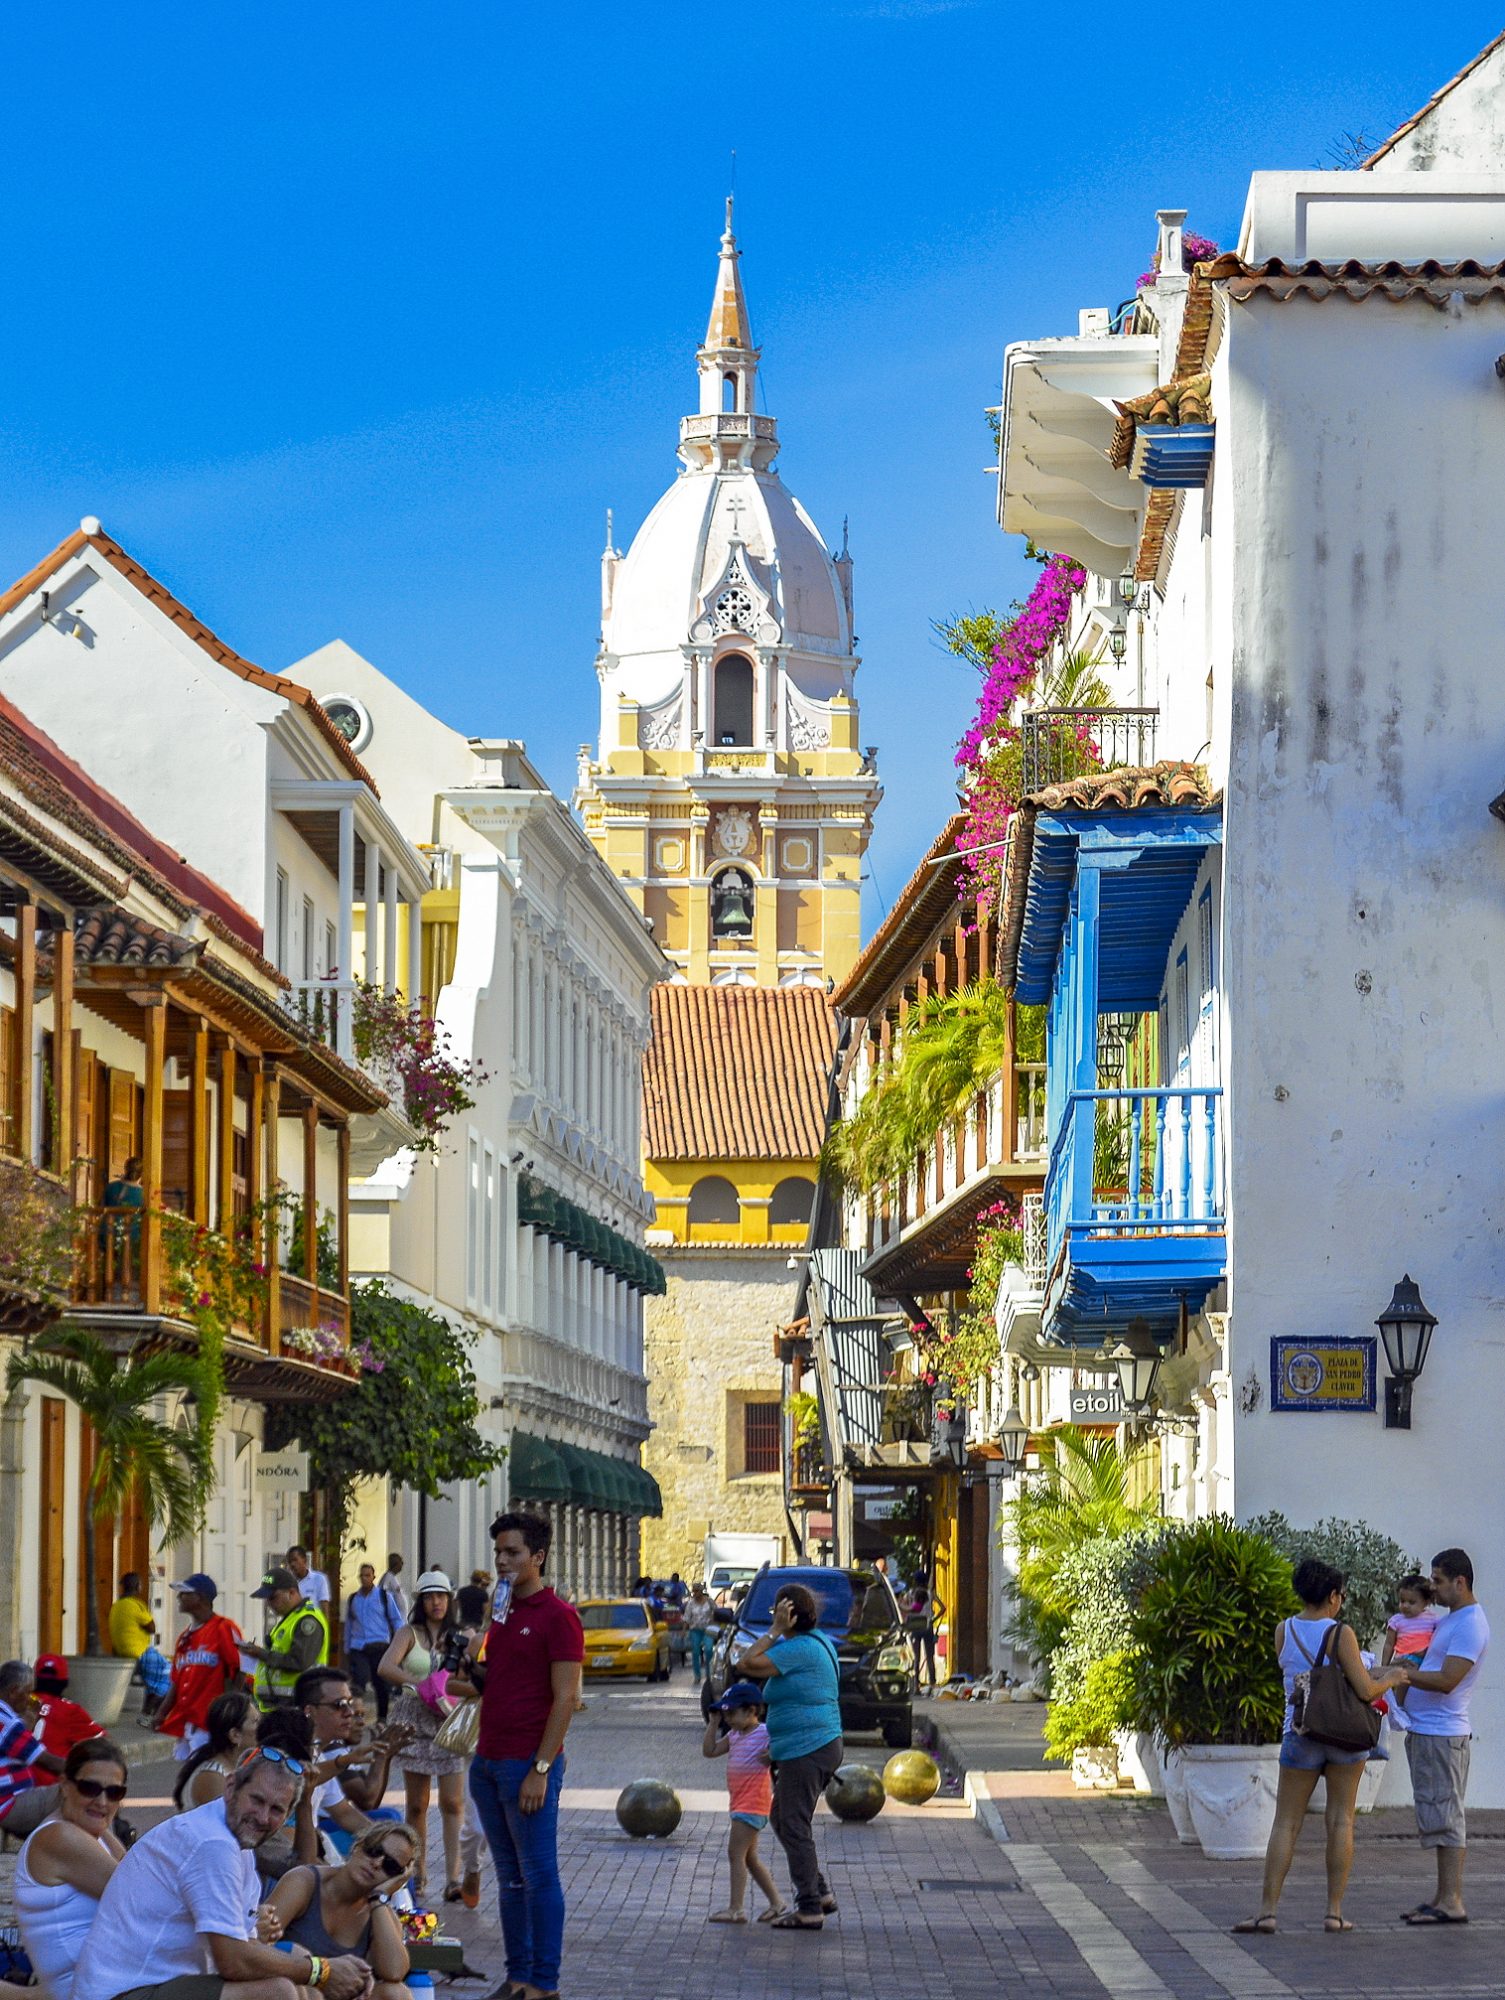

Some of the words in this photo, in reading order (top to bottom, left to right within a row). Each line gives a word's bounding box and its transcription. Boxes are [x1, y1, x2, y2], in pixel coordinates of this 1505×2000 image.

[1328, 1357, 1348, 1367] PLAZA
[1349, 1357, 1358, 1367] DE
[1325, 1369, 1338, 1379] SAN
[1339, 1369, 1361, 1379] PEDRO
[1330, 1382, 1355, 1392] CLAVER
